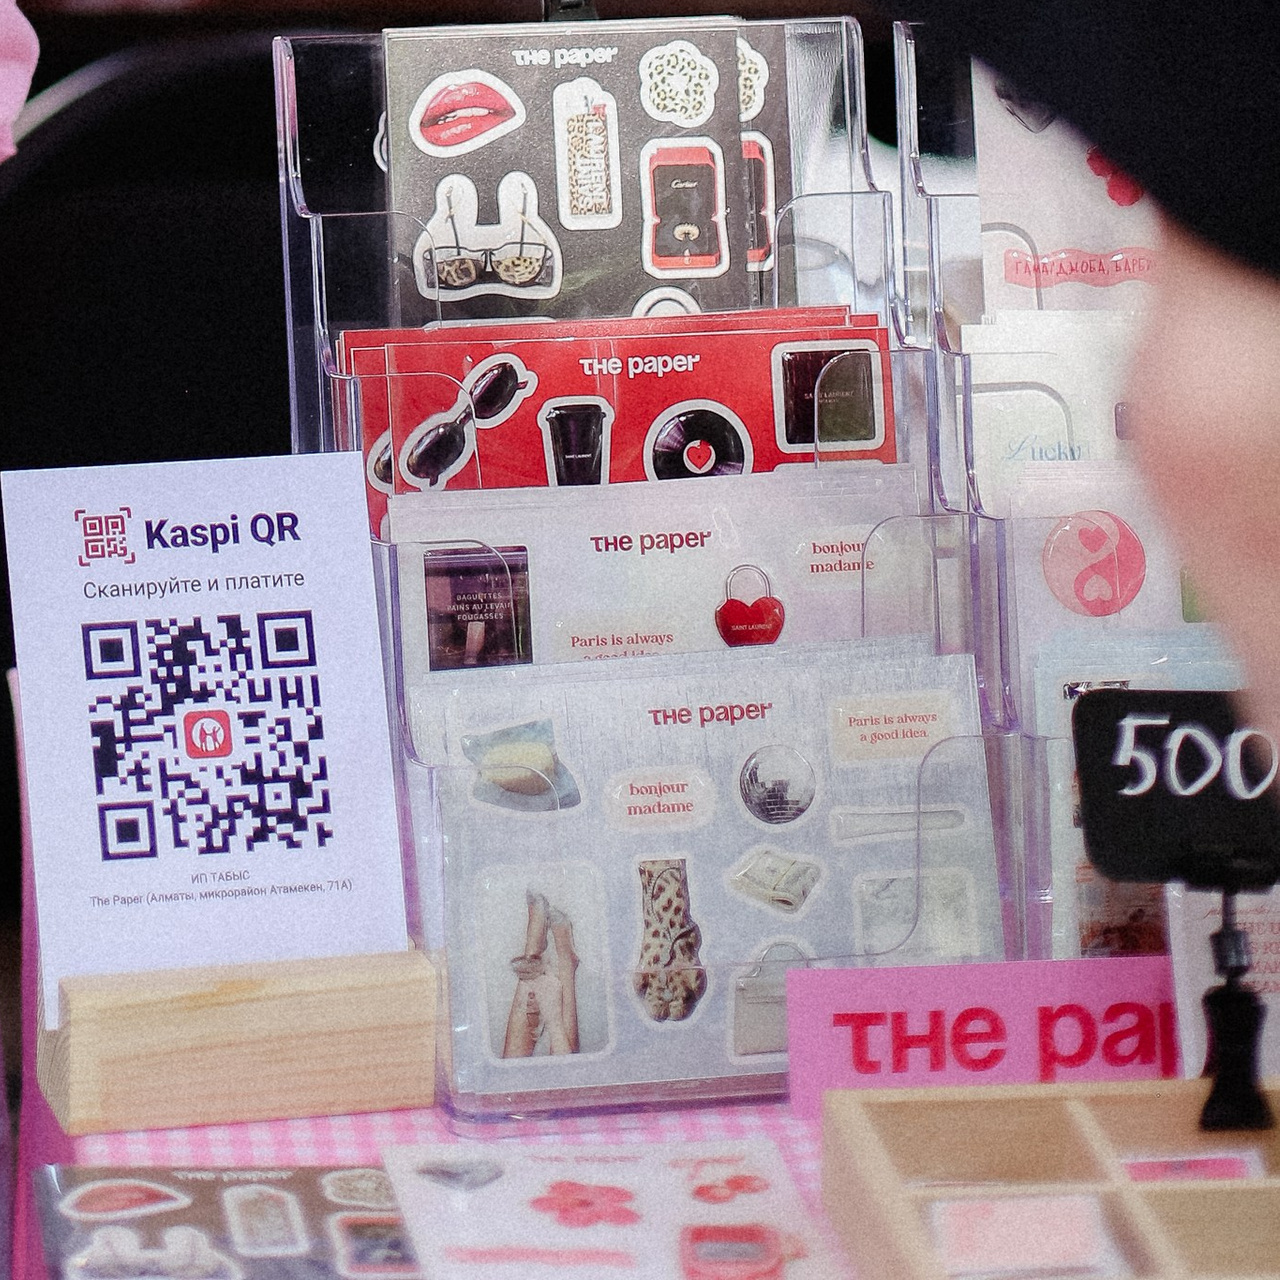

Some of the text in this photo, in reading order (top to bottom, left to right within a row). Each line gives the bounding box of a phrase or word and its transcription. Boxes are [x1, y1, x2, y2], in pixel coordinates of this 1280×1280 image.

[554, 46, 619, 69] paper
[628, 354, 700, 379] paper
[144, 511, 301, 553] Kaspi QR
[639, 531, 712, 556] paper
[83, 572, 305, 600] Сканируйте и платите
[571, 632, 674, 648] Paris is always
[699, 702, 773, 728] paper
[848, 713, 937, 727] Paris is always
[870, 729, 899, 744] good
[629, 781, 689, 798] bonjour
[627, 801, 694, 816] madame
[191, 870, 251, 884] ИП ТАБЫС
[90, 895, 110, 907] The
[113, 894, 143, 907] Paper
[200, 884, 267, 901] микрорайон
